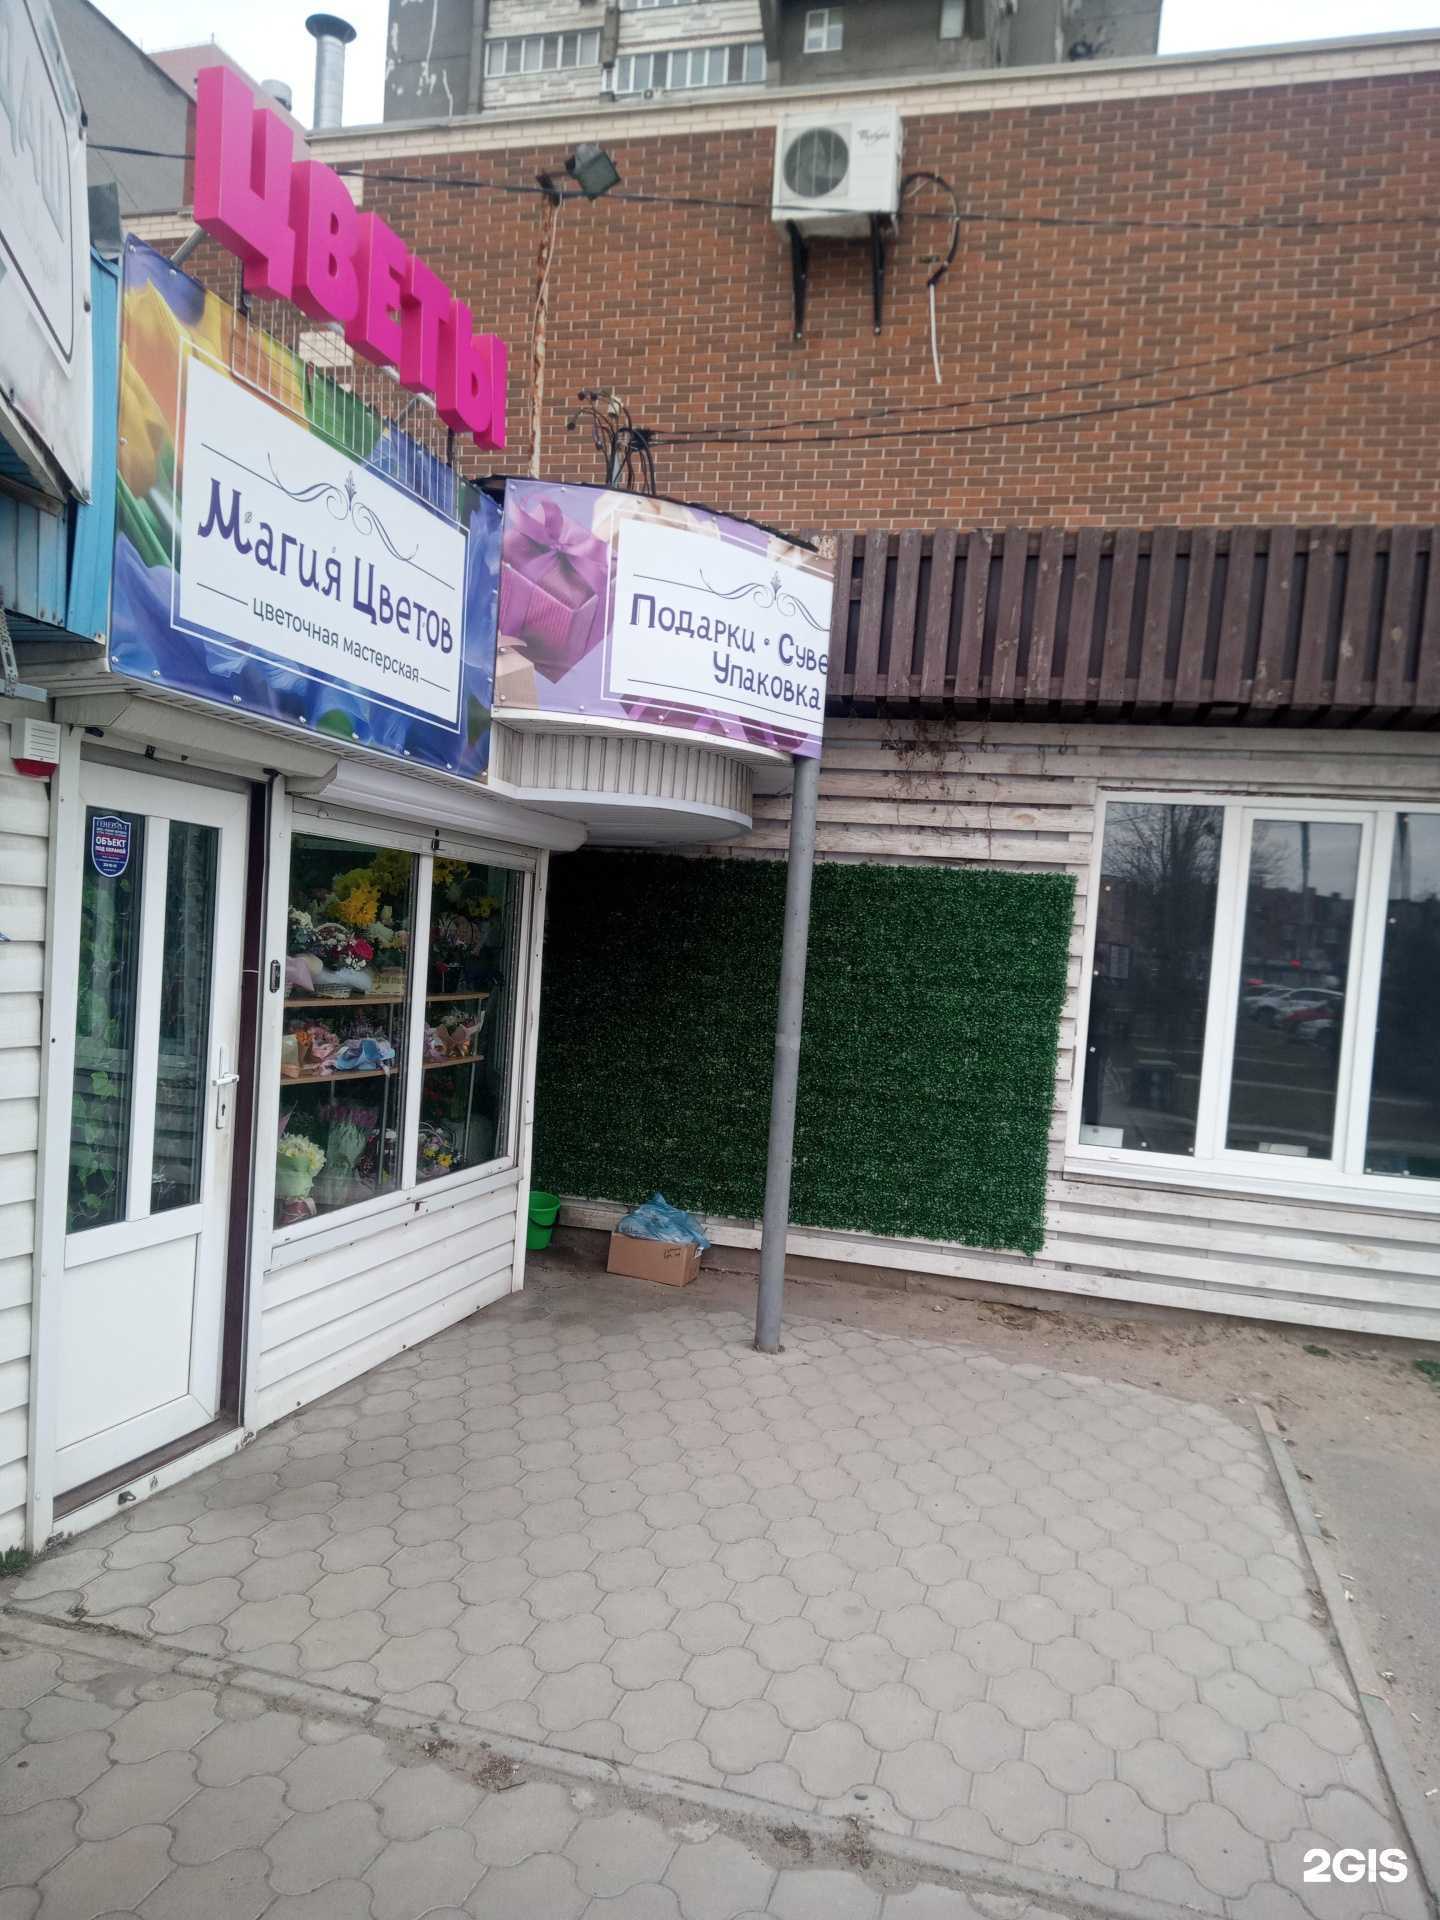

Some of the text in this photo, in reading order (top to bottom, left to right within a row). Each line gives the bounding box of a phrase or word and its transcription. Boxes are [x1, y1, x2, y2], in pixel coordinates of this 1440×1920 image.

[193, 65, 507, 451] ЦВЕТЫ
[197, 477, 453, 655] Магия Цветов
[252, 597, 420, 683] цветочная мастерская
[629, 593, 756, 654] Подарки
[712, 650, 822, 711] Упаковка
[95, 836, 127, 848] ОБЪЕКТ
